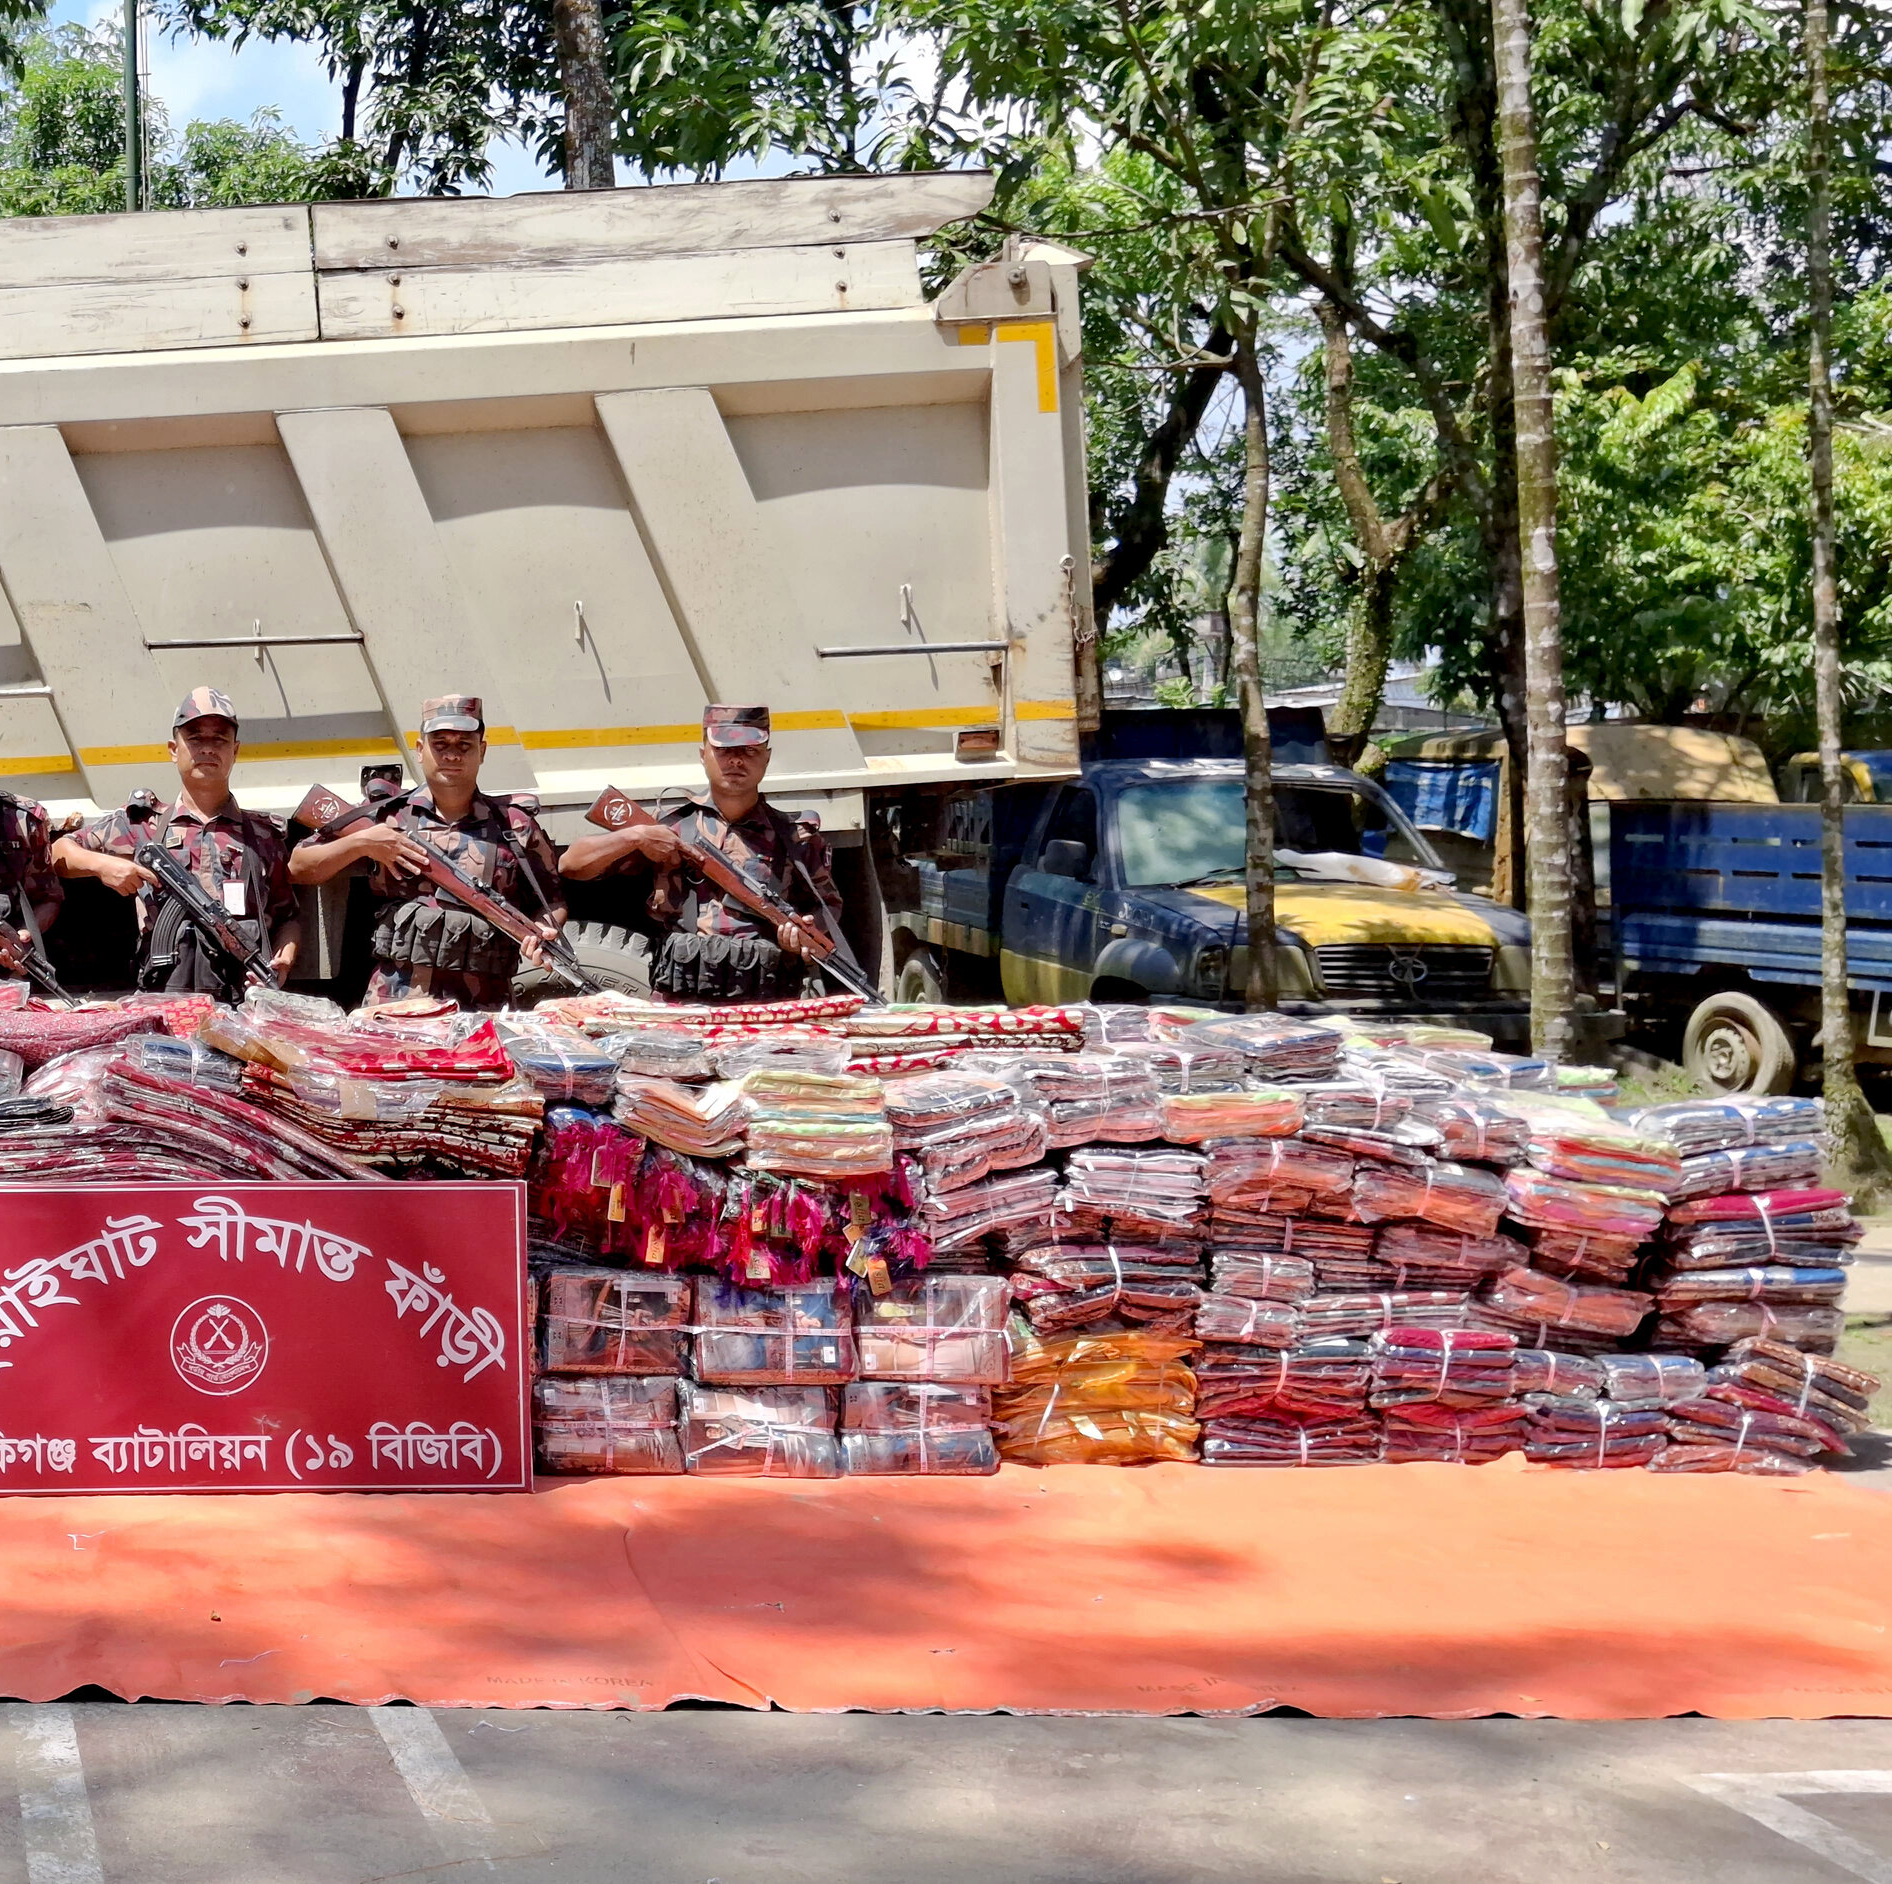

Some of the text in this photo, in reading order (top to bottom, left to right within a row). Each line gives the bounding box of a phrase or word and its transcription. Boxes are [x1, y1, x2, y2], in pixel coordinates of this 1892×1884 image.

[175, 1195, 374, 1282] সীমান্ত
[384, 1257, 506, 1384] ফাঁড়ী
[87, 1422, 273, 1473] ব্যাটালিয়ন
[285, 1428, 354, 1480] (১৯
[365, 1421, 503, 1480] বিজিবি)
